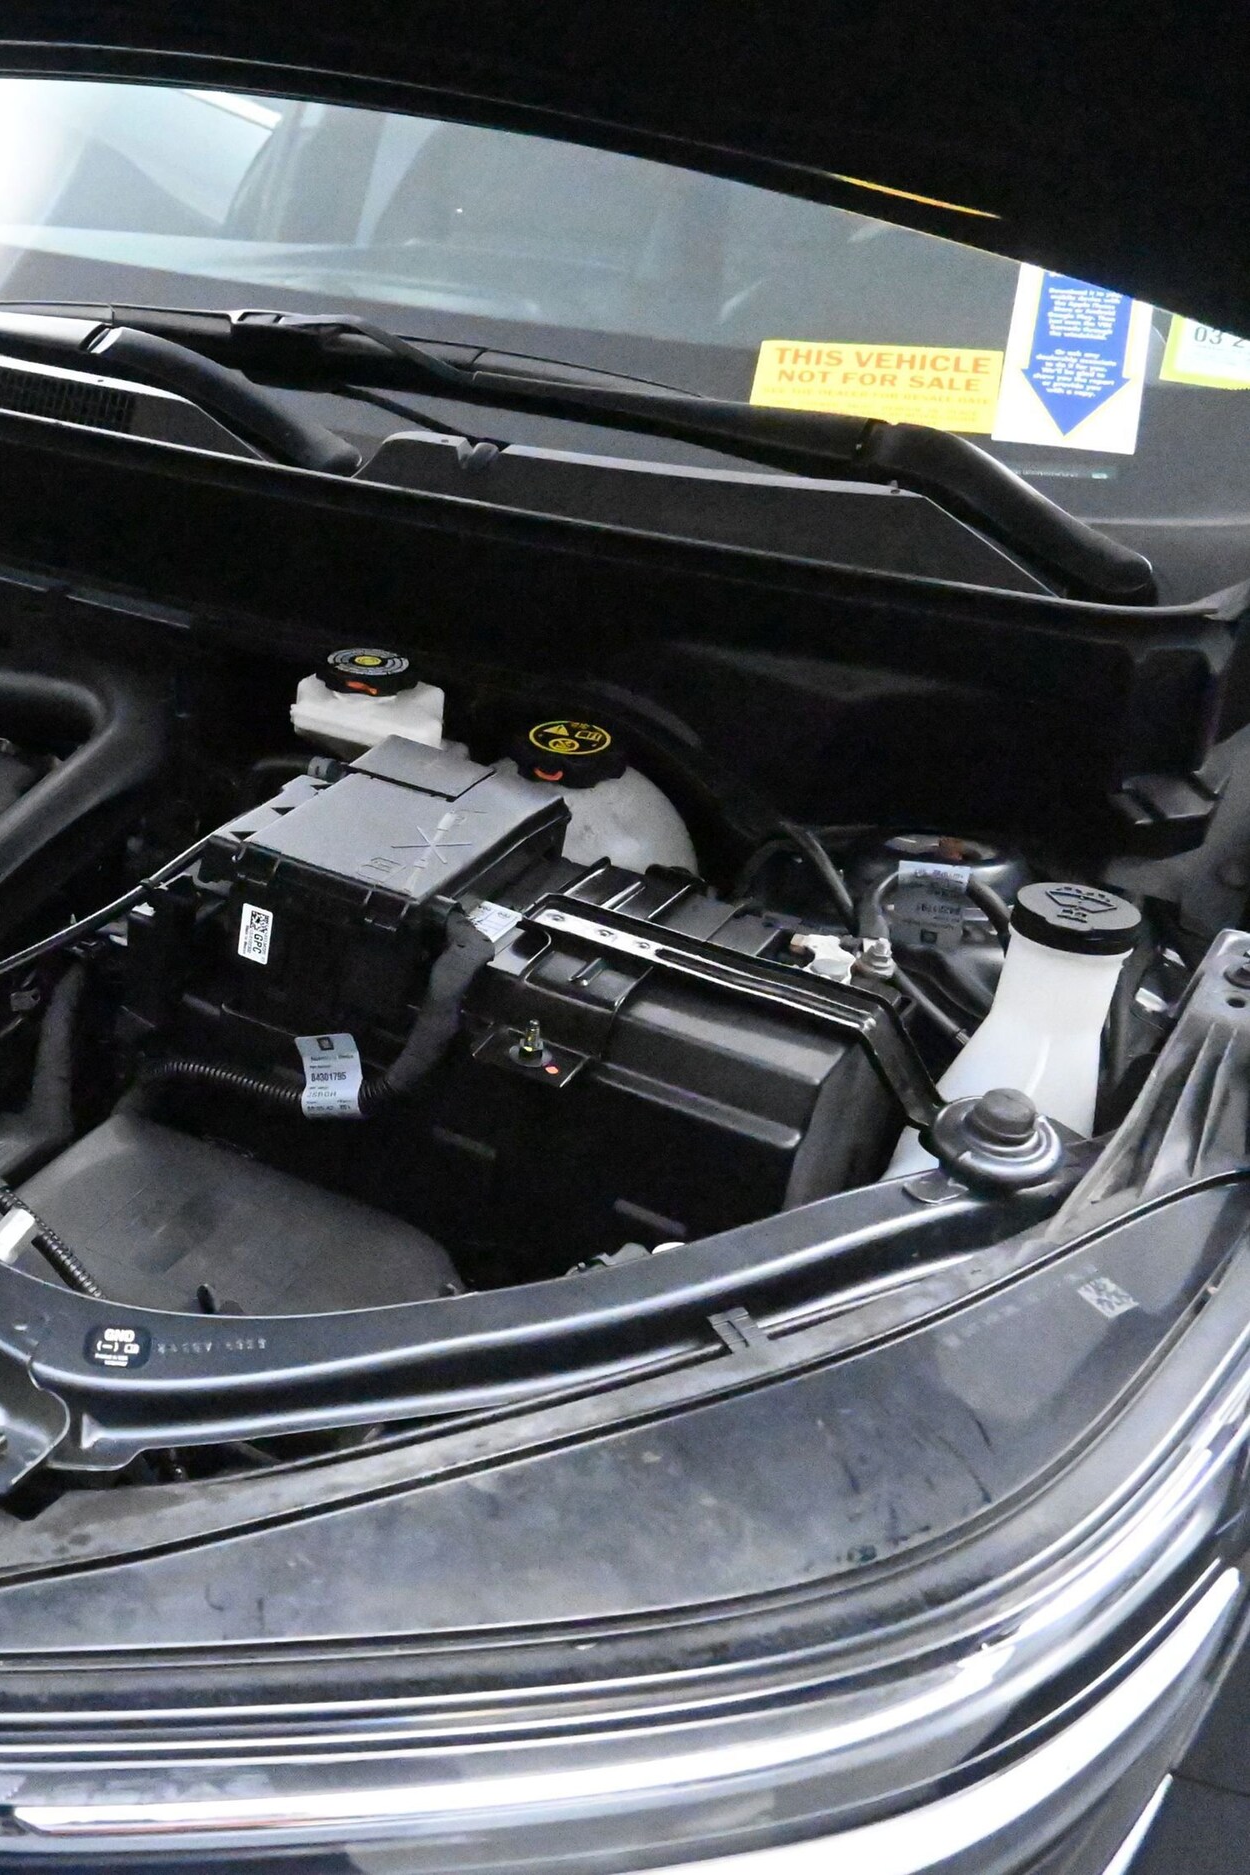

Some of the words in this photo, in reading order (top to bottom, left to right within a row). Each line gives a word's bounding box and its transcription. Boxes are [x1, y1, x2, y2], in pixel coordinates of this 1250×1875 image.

[1194, 326, 1223, 345] 03
[775, 347, 843, 367] THIS
[854, 351, 991, 374] VEHICLE
[777, 369, 832, 384] NOT
[842, 371, 898, 387] FOR
[908, 375, 981, 392] SALE
[252, 933, 264, 954] GPC
[104, 1328, 135, 1343] GND
